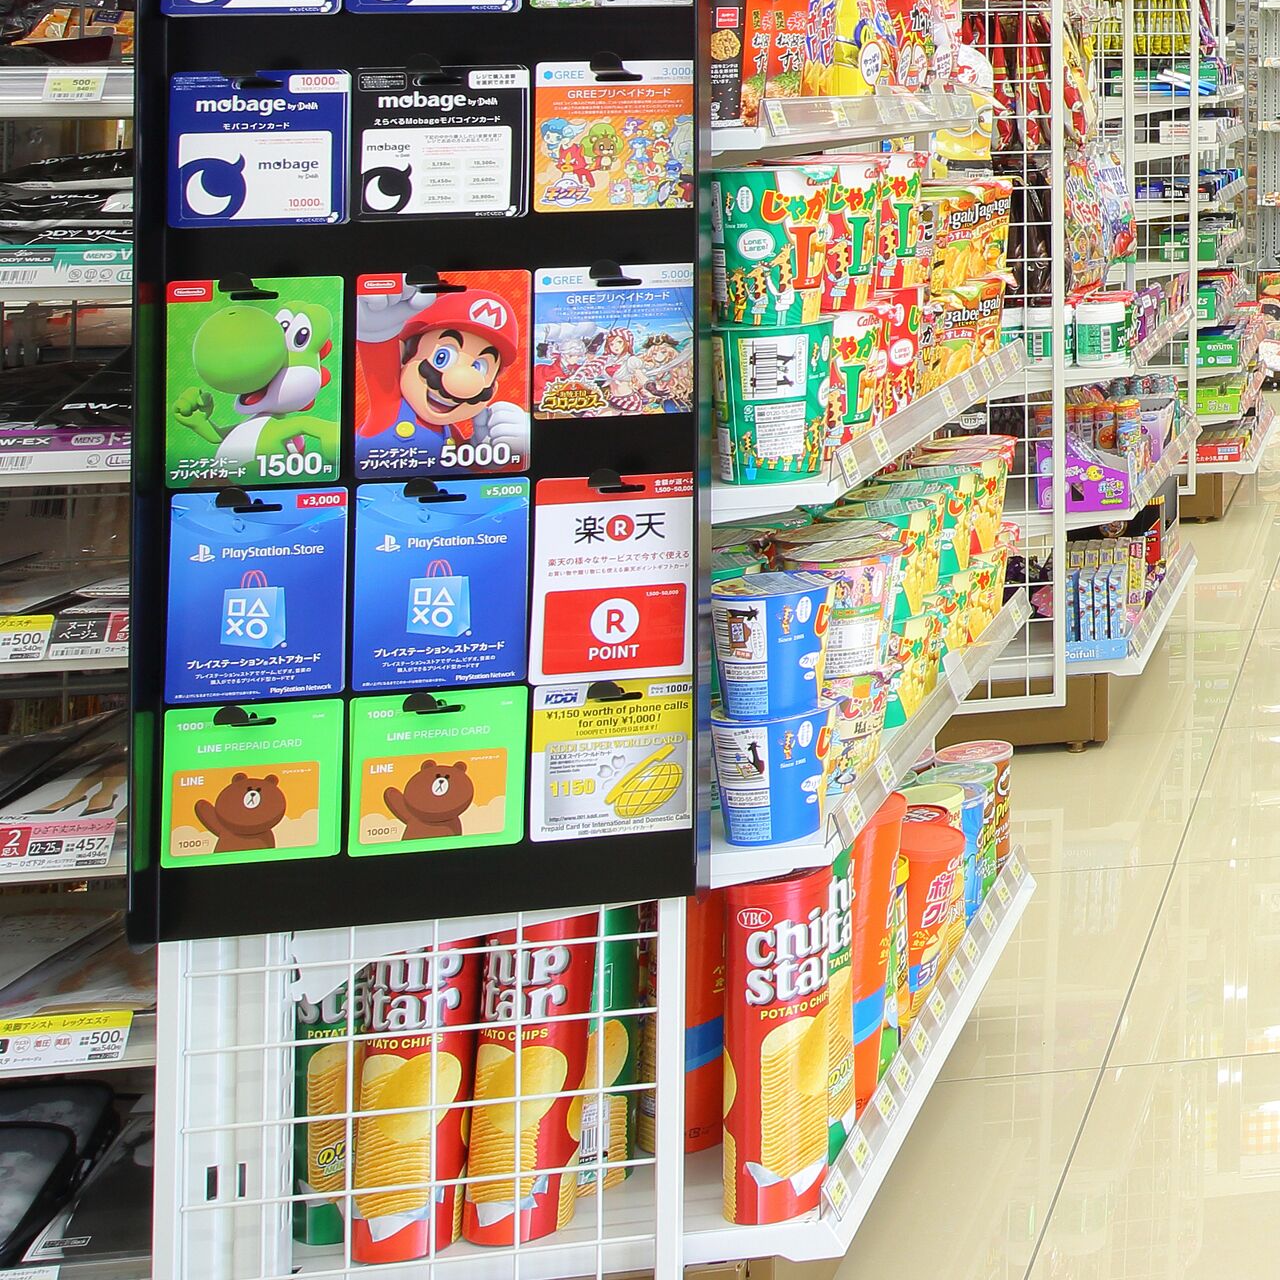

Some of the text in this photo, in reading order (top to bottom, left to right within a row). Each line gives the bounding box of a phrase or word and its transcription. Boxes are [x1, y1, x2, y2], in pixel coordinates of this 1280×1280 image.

[554, 70, 585, 80] GREE
[567, 87, 672, 100] GREEプリペイドカード
[195, 95, 286, 116] mobage
[374, 115, 501, 127] えらべるMobageモバコインカード
[848, 216, 870, 275] L
[789, 226, 817, 290] L
[174, 288, 207, 298] Nintendo
[368, 448, 429, 459] ニンテンドー
[439, 444, 521, 467] 5000円
[178, 458, 239, 469] ニンテンドー
[256, 452, 333, 478] 1500円
[360, 456, 437, 471] プリペイドカード
[170, 467, 247, 480] プリペイドカード
[485, 485, 523, 497] ¥5,000
[302, 494, 341, 507] ¥3,000
[477, 532, 508, 546] Store
[293, 542, 325, 556] Store
[548, 550, 690, 567] 楽天の様々なサービスで今すぐ使える
[67, 620, 97, 631] ヌード
[59, 629, 99, 642] ベージュ
[588, 644, 639, 661] POINT
[1062, 648, 1097, 660] Poifull
[544, 692, 579, 705] KDDI
[546, 701, 689, 720] ¥1,150 worth of phone calls
[578, 717, 618, 731] for only
[386, 725, 491, 742] LINE PREPAID CARD
[224, 738, 303, 753] PREPAID CARD
[370, 763, 394, 774] LINE
[180, 776, 205, 787] LINE
[549, 778, 596, 797] 1150
[33, 822, 114, 836] ひざ下丈ストッキング
[75, 837, 105, 852] 457
[741, 911, 766, 924] YBC
[760, 1002, 807, 1020] POTATO
[89, 1028, 121, 1045] 500
